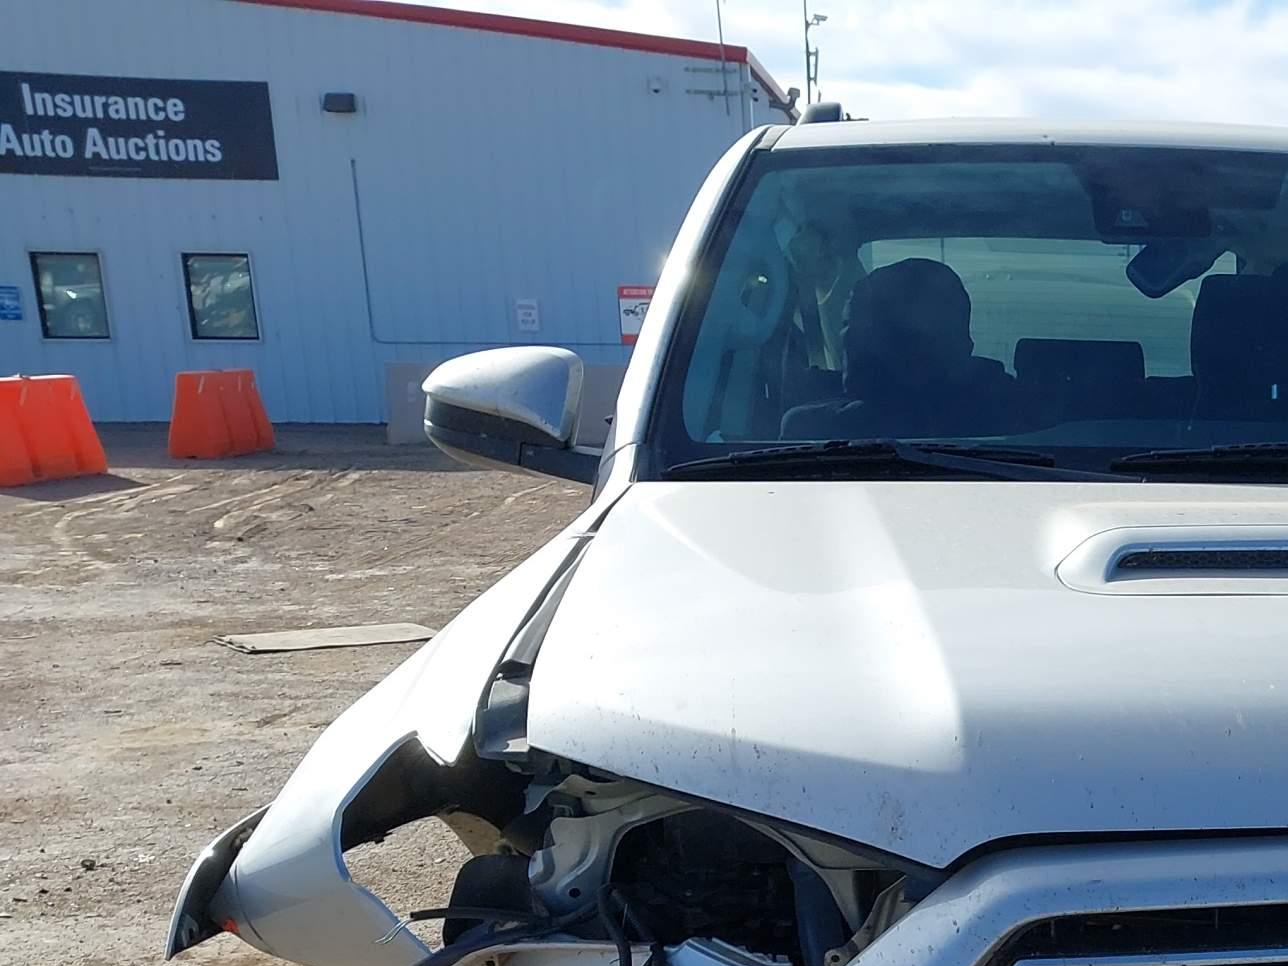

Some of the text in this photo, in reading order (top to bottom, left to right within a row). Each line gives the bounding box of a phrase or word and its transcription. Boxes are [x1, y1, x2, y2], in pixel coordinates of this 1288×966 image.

[21, 83, 185, 121] Insurance
[0, 124, 223, 162] Auto Auctions
